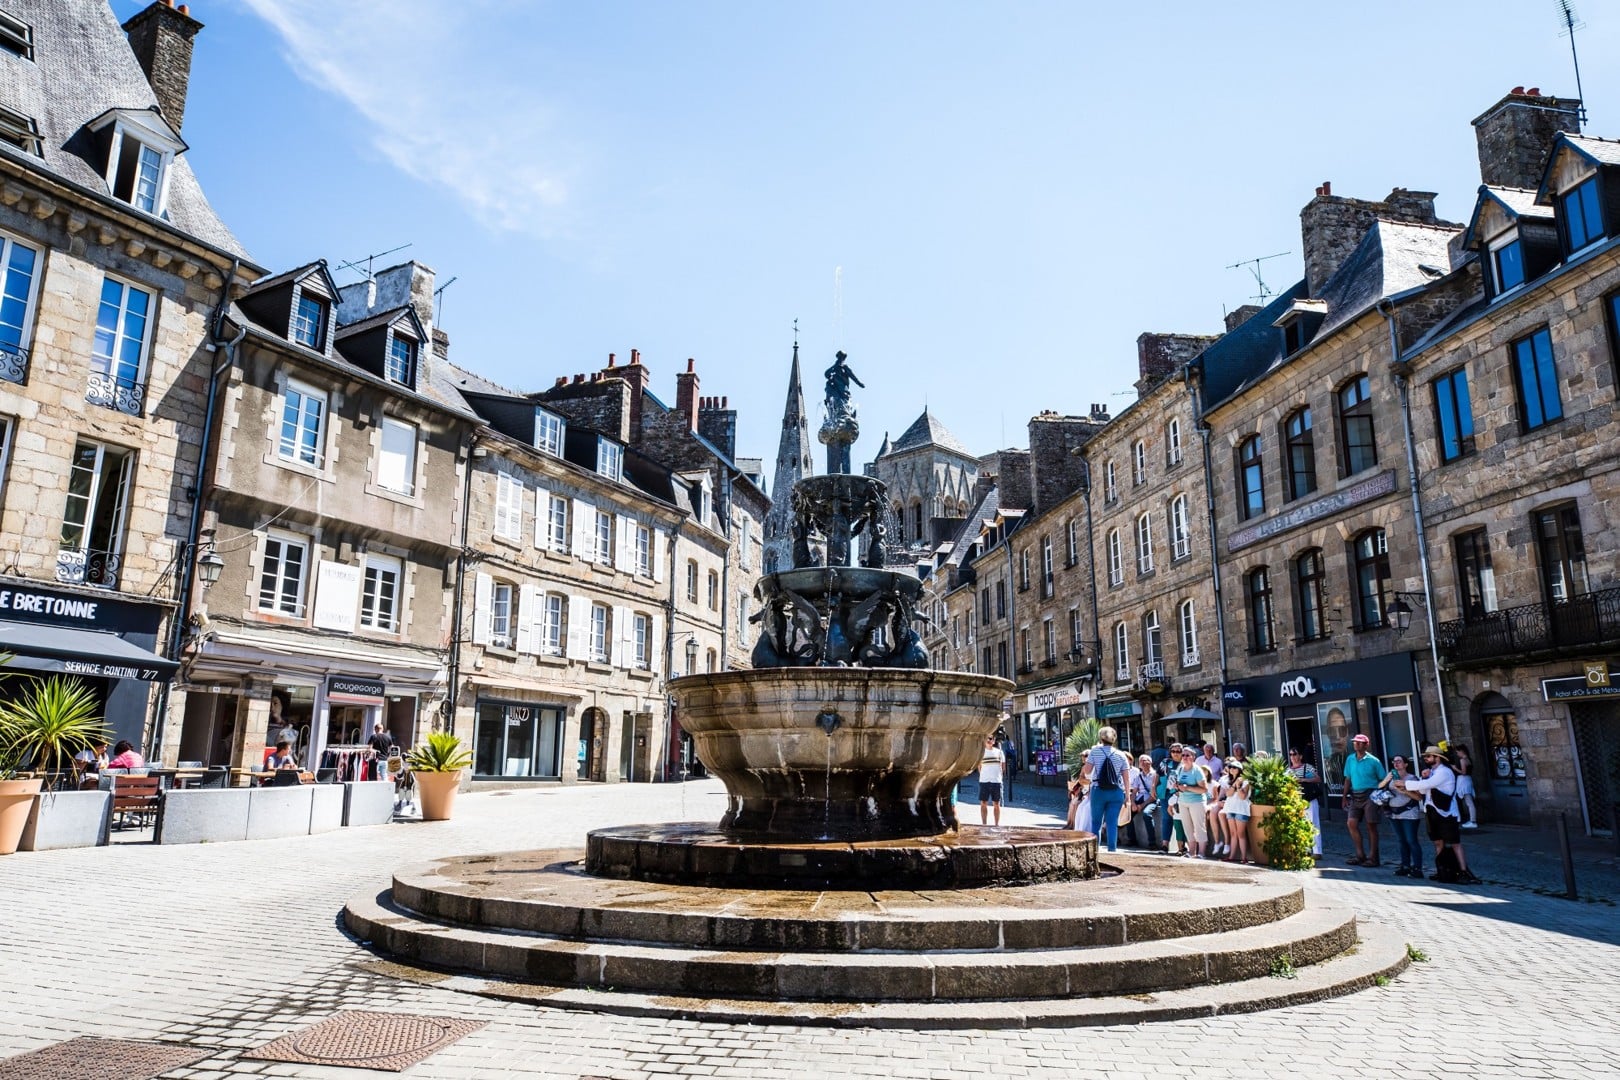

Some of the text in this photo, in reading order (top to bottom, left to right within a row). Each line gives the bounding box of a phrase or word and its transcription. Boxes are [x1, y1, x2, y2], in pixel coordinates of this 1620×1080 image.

[13, 593, 98, 619] BRETONNE
[65, 661, 158, 679] SERVICE CONTINU 7/7
[1588, 670, 1606, 683] Or
[1224, 691, 1243, 699] ATOL
[1280, 676, 1316, 698] ATOL
[1034, 691, 1057, 709] happy
